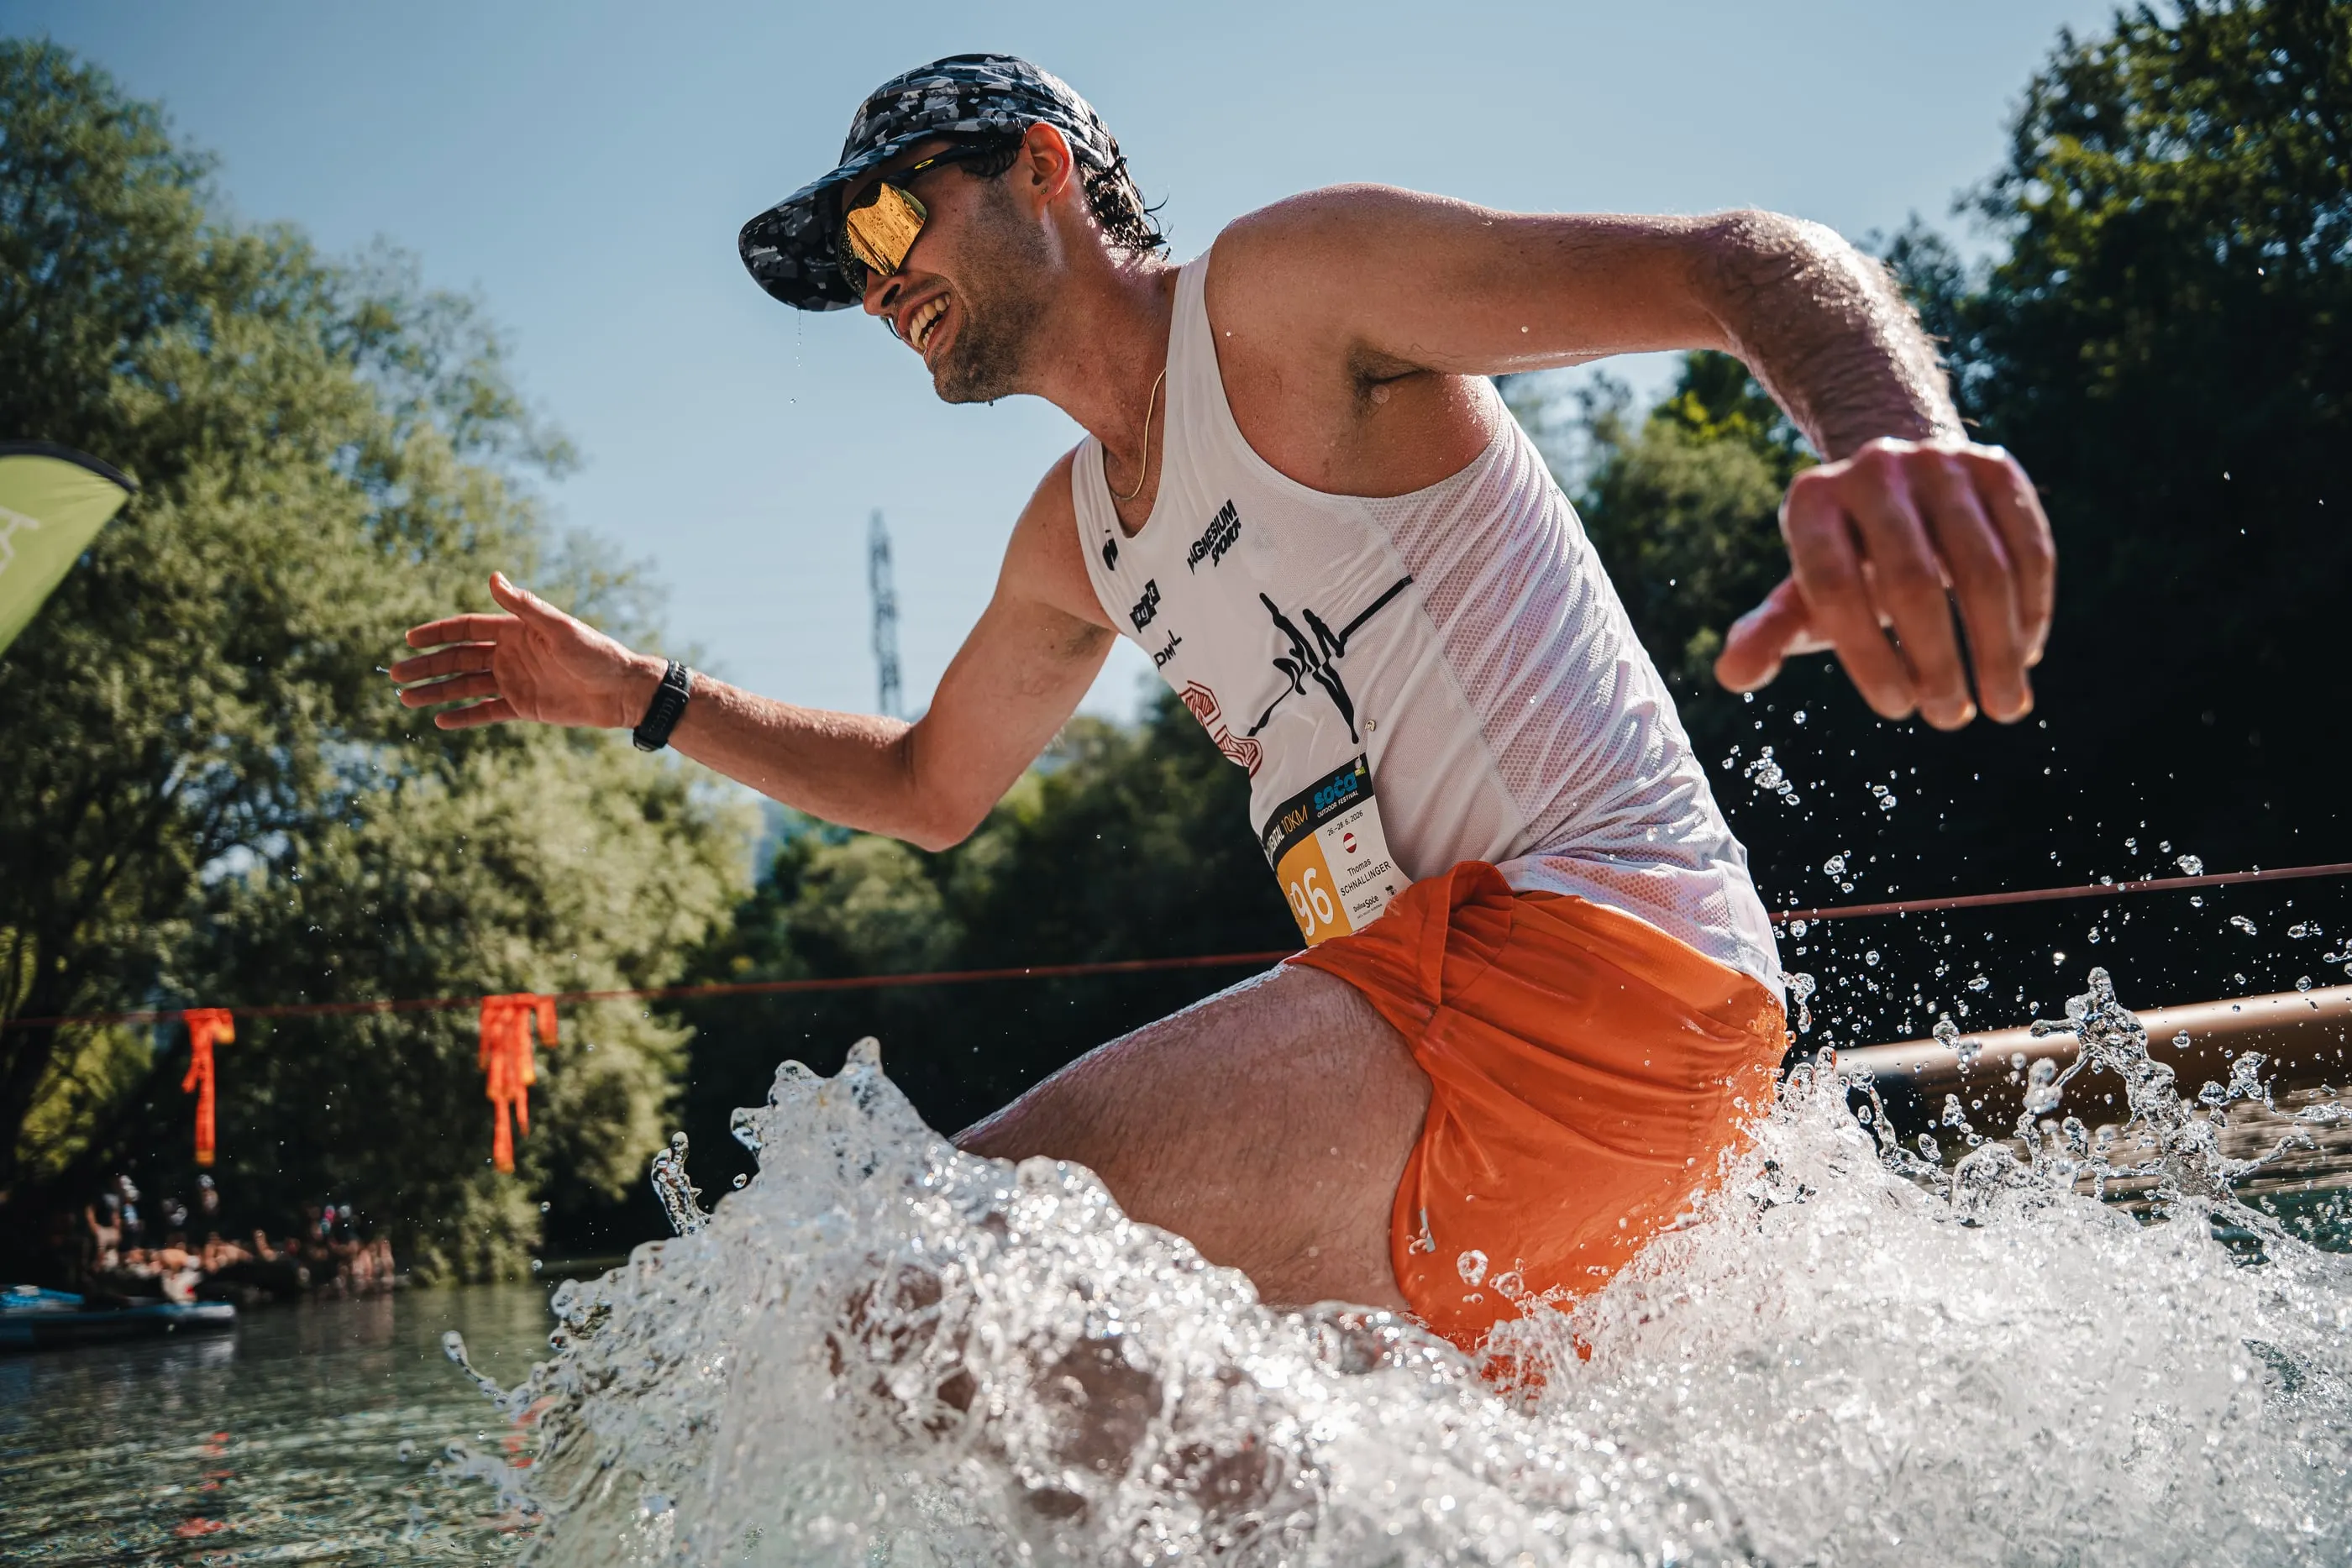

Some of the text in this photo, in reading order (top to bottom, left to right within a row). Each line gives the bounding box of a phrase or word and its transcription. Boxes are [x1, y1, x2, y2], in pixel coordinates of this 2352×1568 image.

[1317, 790, 1358, 818] OUTDOOR FESTIVAL
[1350, 810, 1363, 822] 2026
[1281, 805, 1308, 834] 10KM
[1340, 861, 1392, 897] SCHNALLINGER
[1347, 858, 1372, 877] Thomas
[1289, 868, 1334, 936] 96
